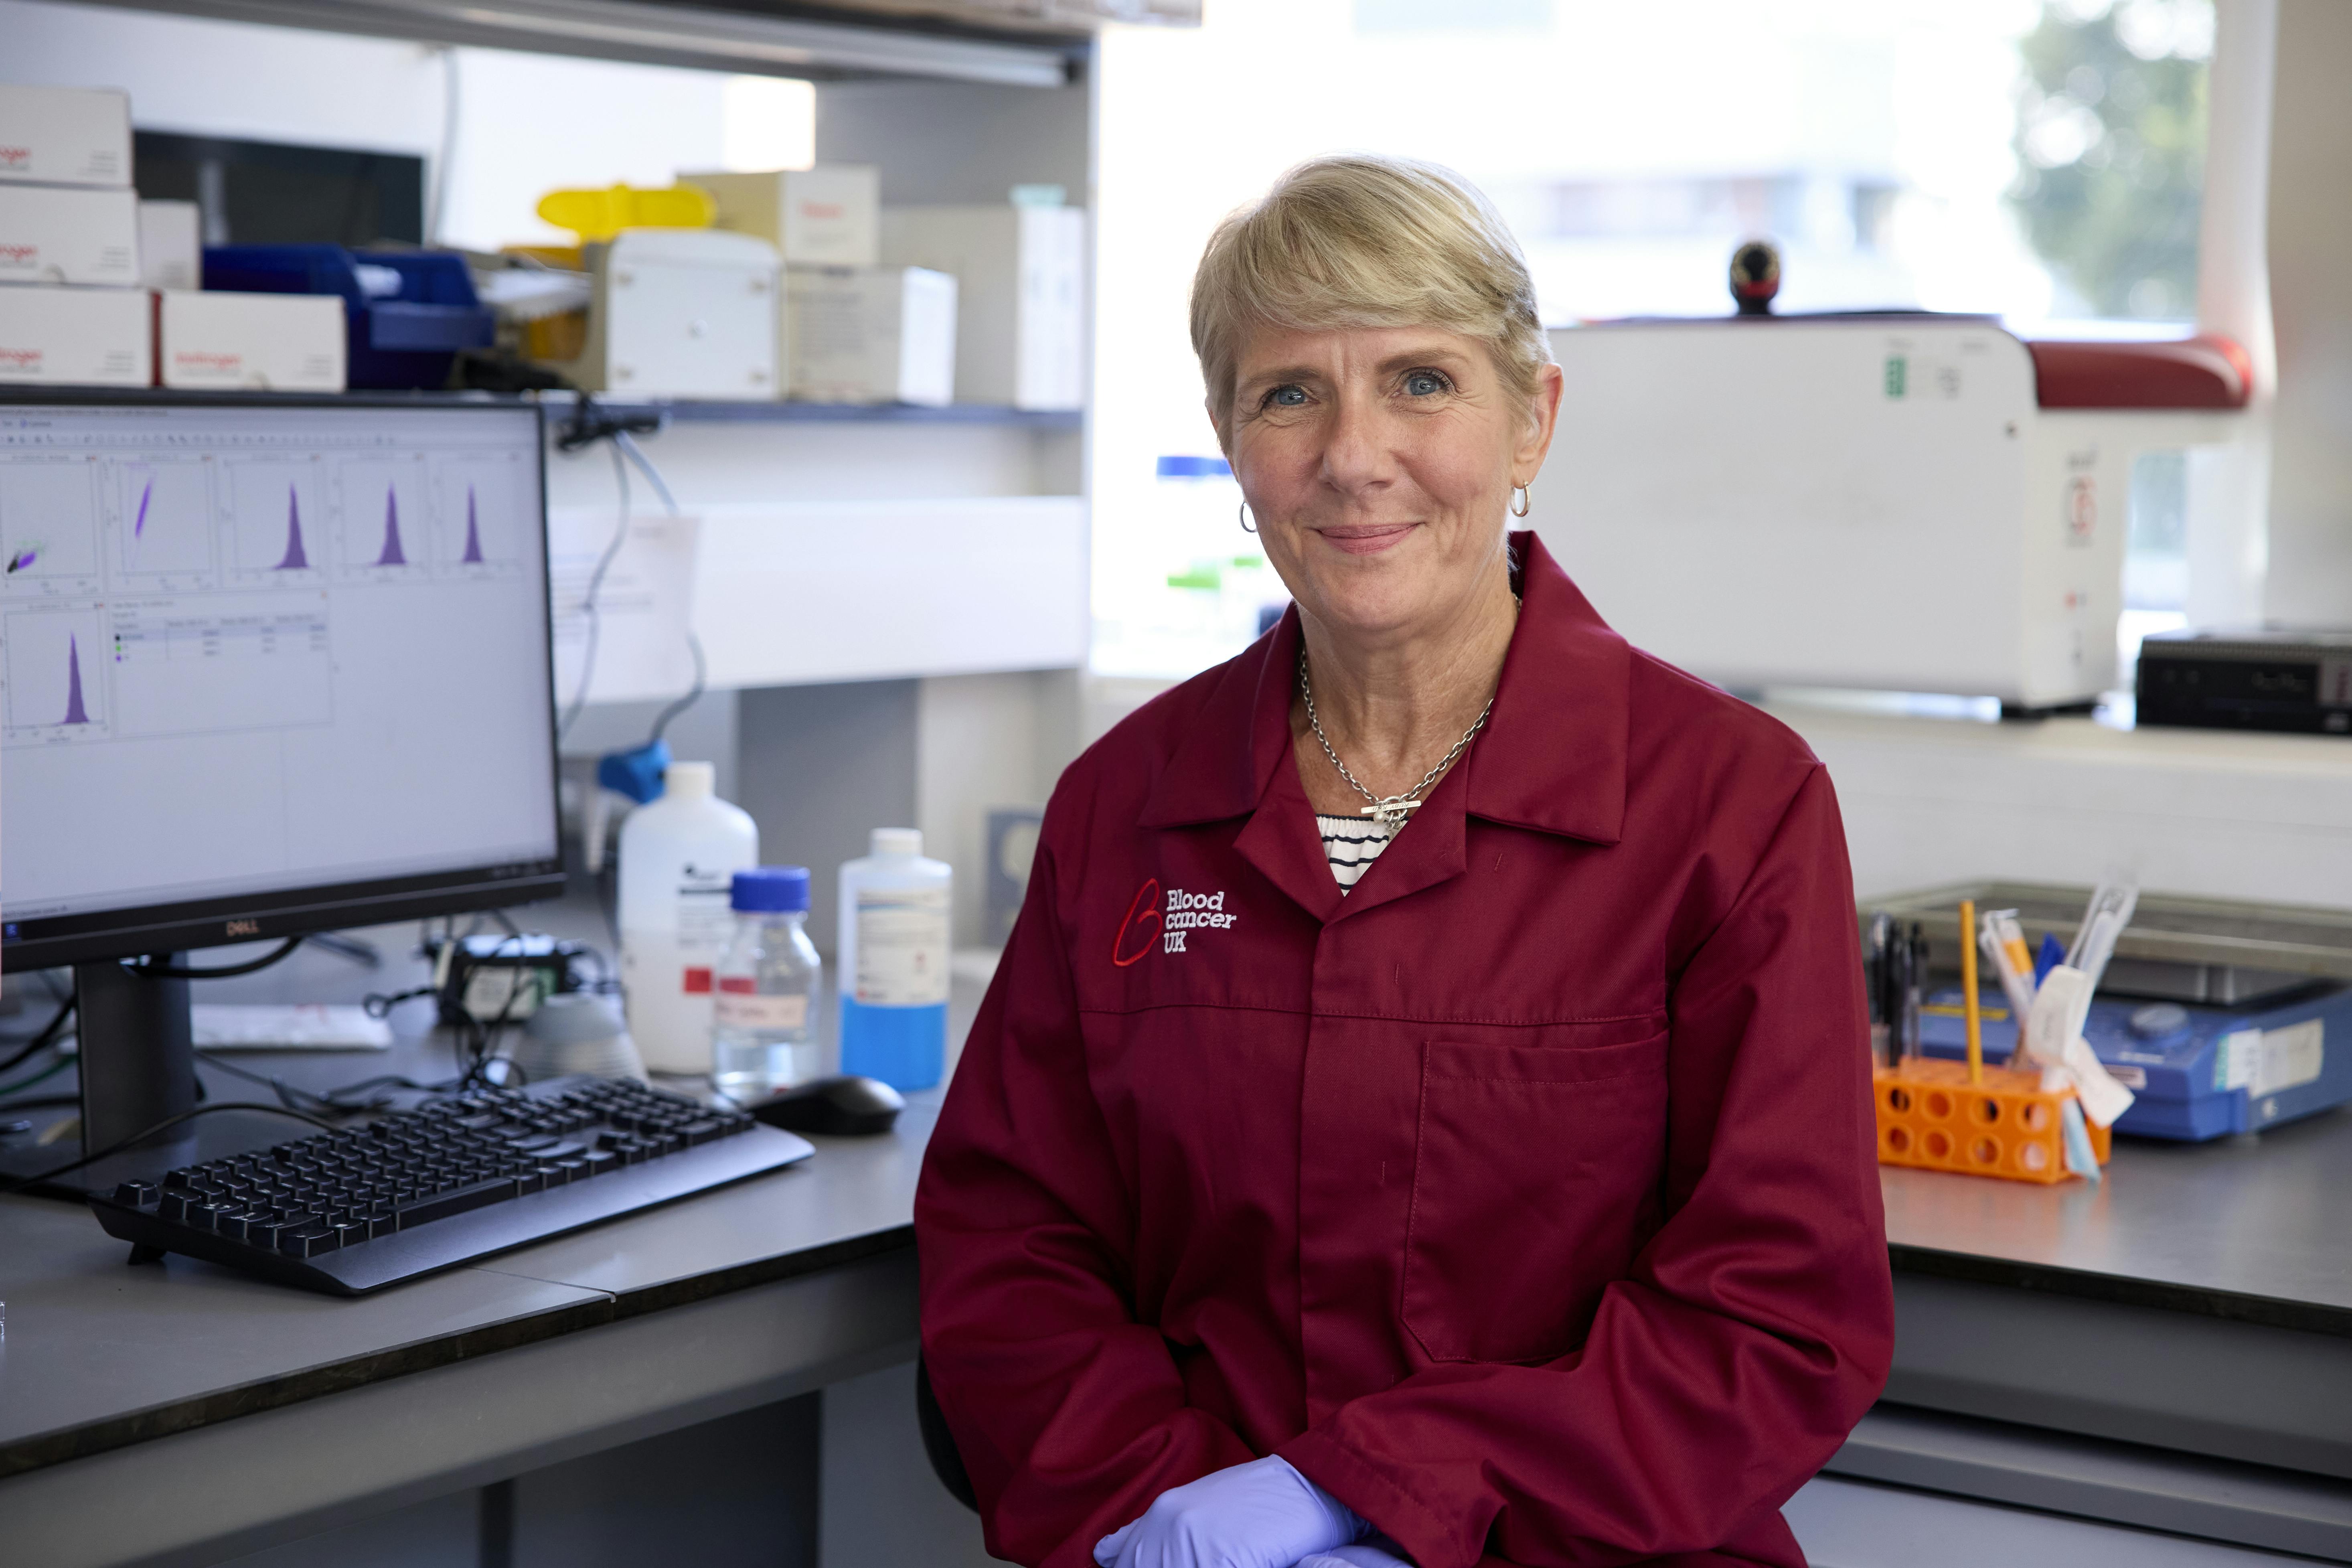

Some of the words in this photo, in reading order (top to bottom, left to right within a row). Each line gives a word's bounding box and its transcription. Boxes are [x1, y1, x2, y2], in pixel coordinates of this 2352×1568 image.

[1166, 889, 1225, 911] Blood
[227, 920, 260, 937] DELL
[1165, 912, 1237, 929] cancer
[1163, 930, 1187, 954] UK
